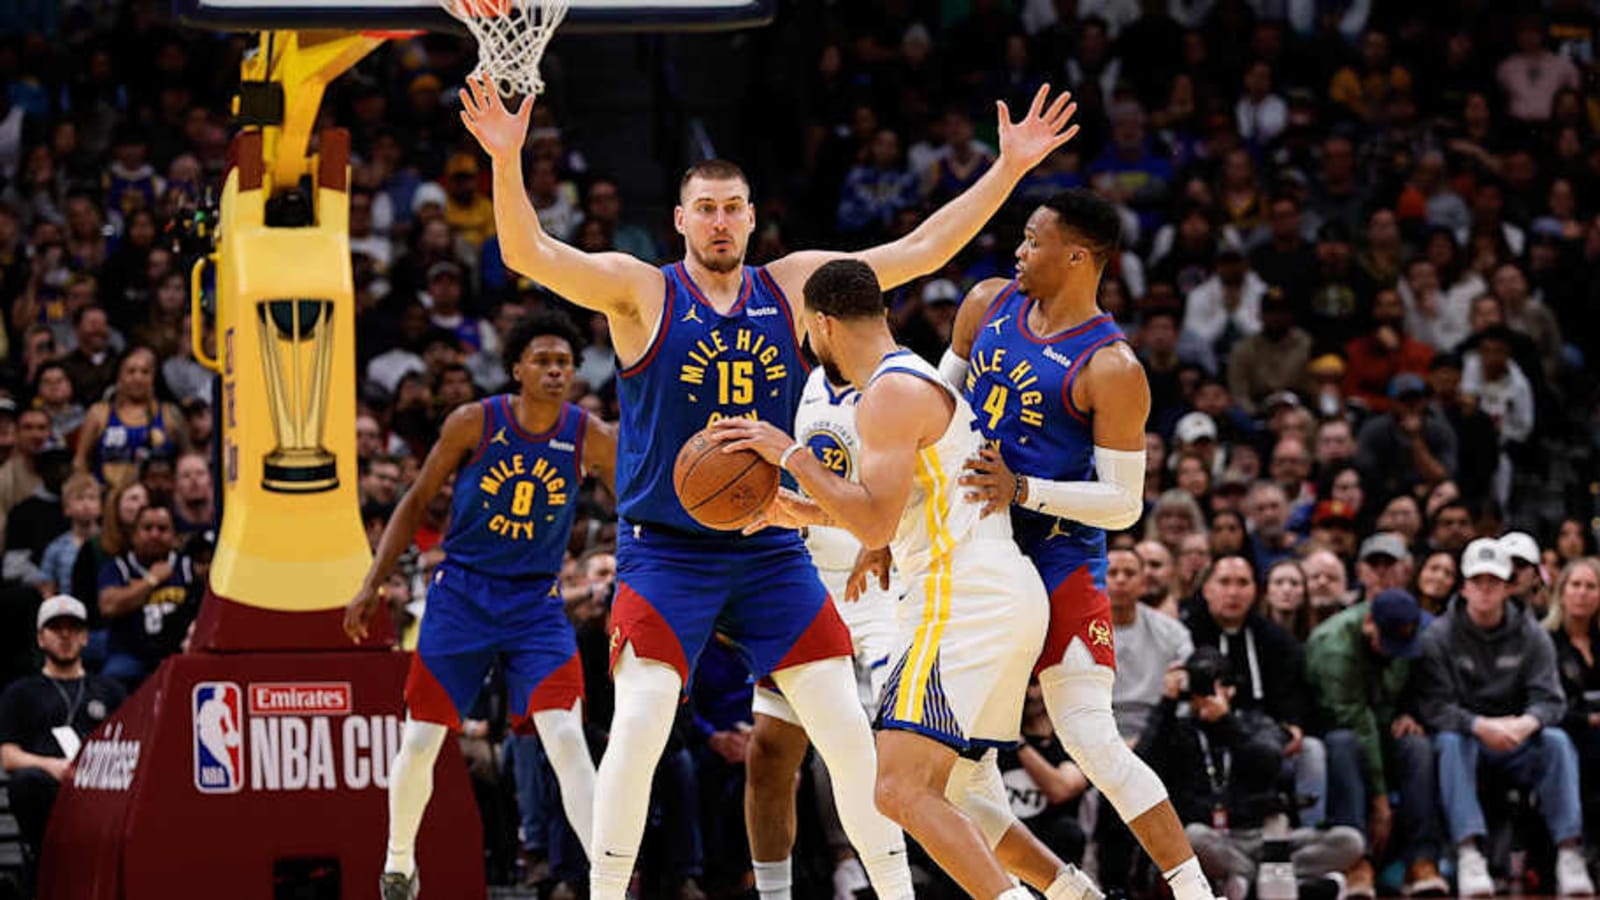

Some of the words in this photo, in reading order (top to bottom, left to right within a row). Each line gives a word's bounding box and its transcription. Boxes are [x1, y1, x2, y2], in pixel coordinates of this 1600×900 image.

[680, 329, 729, 384] MILE
[736, 327, 788, 380] HIGH
[717, 360, 753, 405] 15
[966, 348, 1006, 393] MILE
[1008, 360, 1044, 428] HIGH
[983, 384, 1008, 431] 4
[480, 454, 525, 496] MILE
[531, 457, 567, 506] HIGH
[822, 447, 845, 470] 32
[511, 480, 536, 517] 8
[488, 514, 534, 540] CITY
[256, 686, 344, 709] Emirates
[250, 715, 337, 790] NBA
[342, 715, 402, 790] CU
